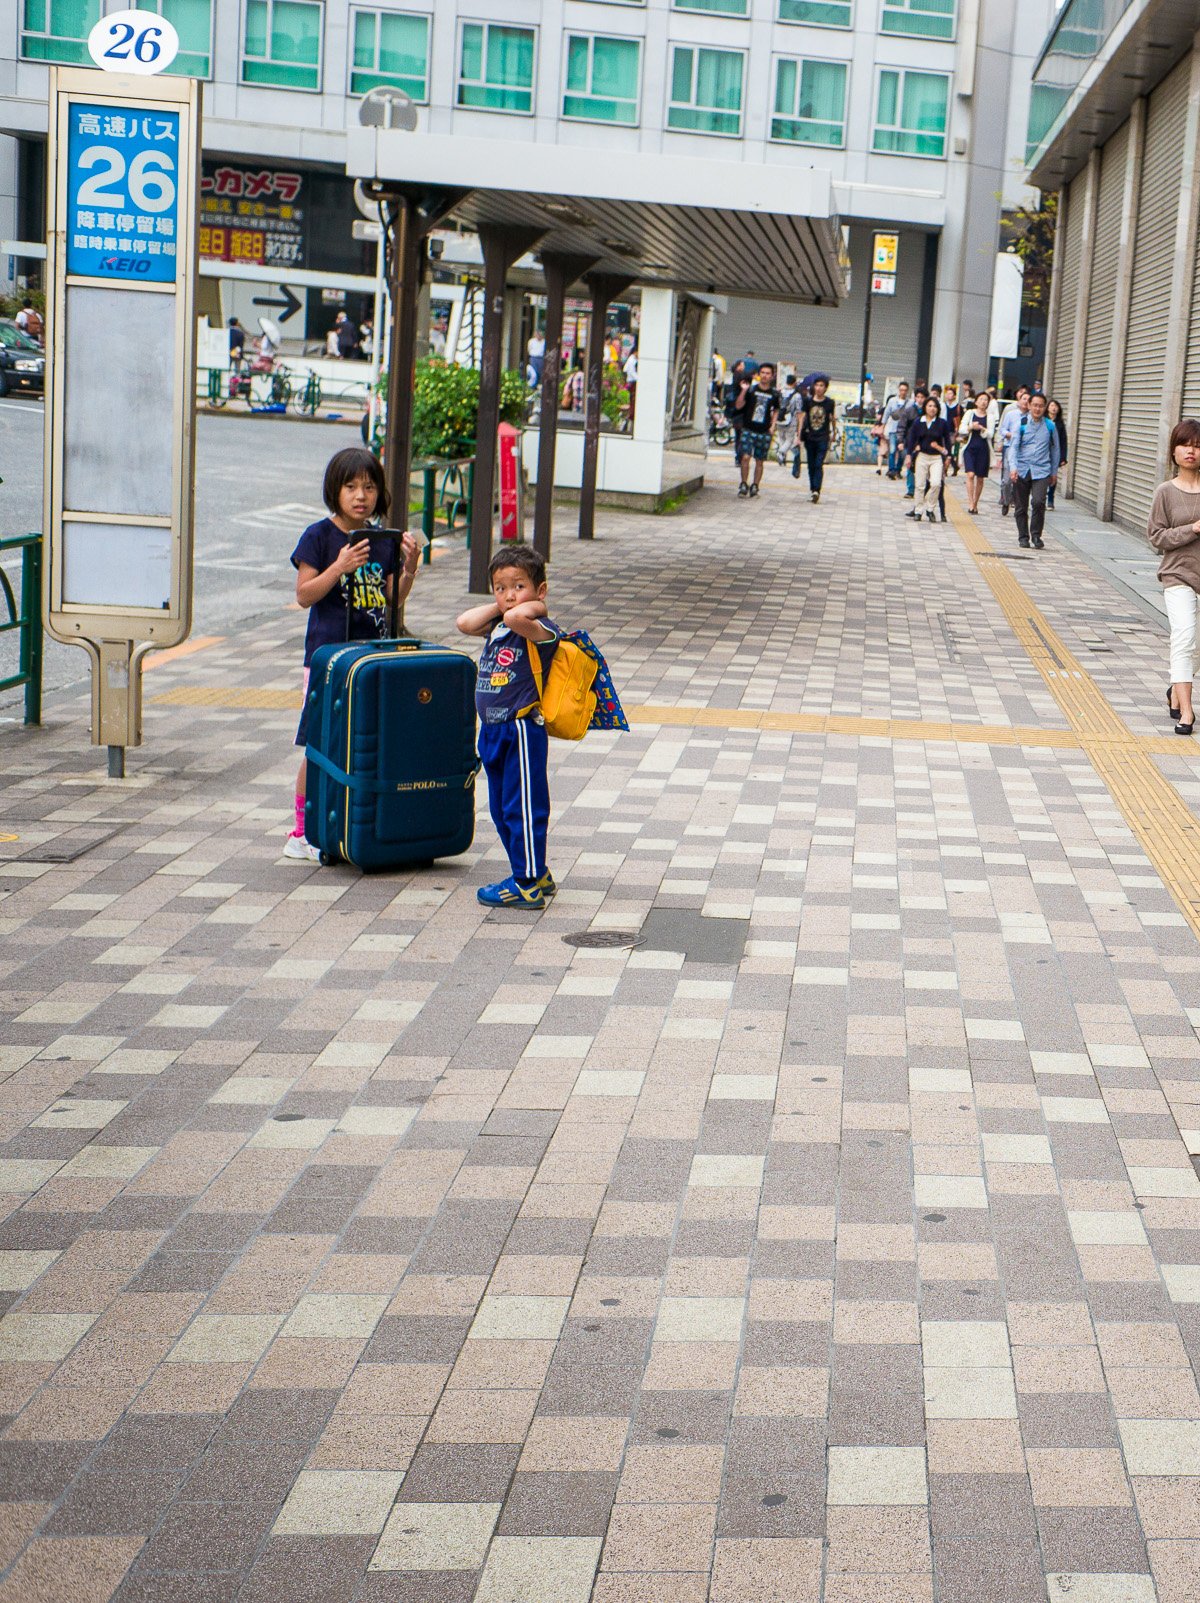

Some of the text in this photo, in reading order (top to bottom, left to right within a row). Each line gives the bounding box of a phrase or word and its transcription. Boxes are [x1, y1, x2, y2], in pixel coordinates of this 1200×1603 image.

[103, 23, 163, 63] 26
[78, 113, 176, 142] 高速バス
[76, 145, 176, 213] 26
[76, 210, 175, 236] 降車停留場
[73, 234, 176, 257] 臨時乗車停留場
[98, 256, 152, 273] KEIO
[413, 780, 436, 790] POLO
